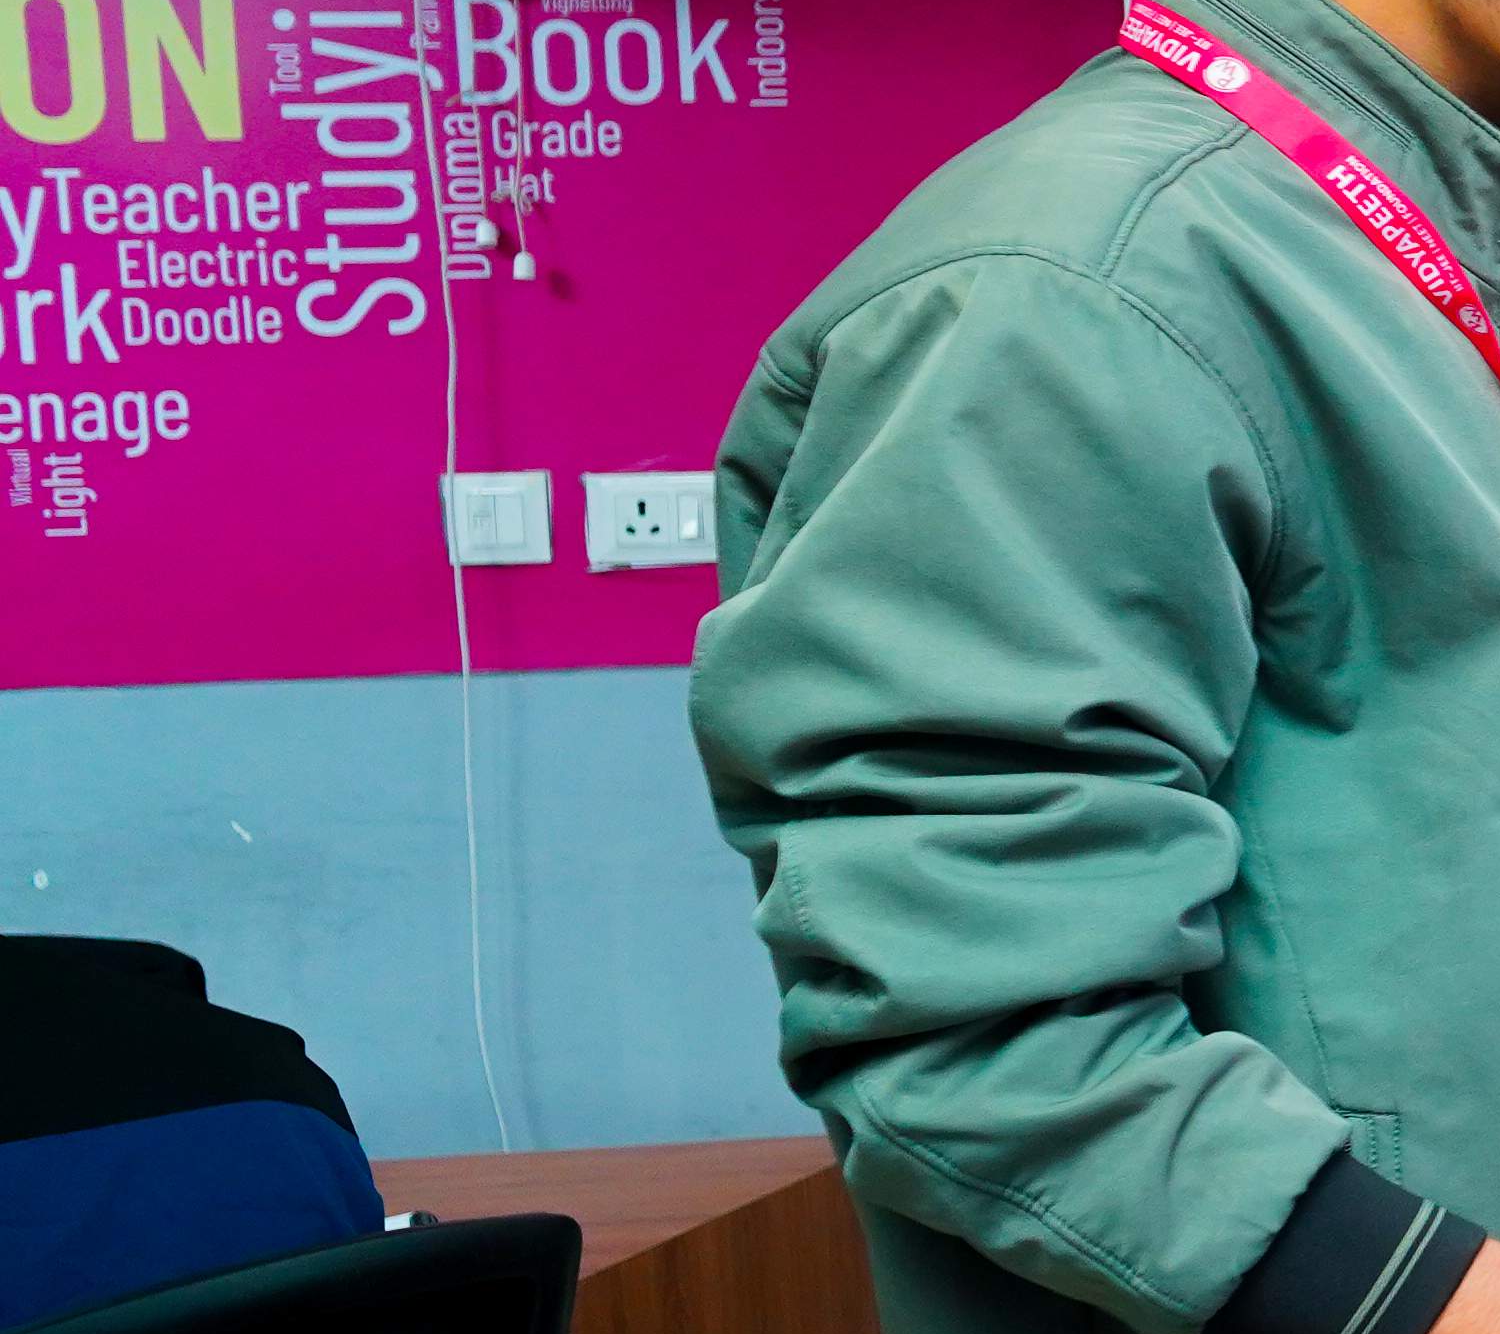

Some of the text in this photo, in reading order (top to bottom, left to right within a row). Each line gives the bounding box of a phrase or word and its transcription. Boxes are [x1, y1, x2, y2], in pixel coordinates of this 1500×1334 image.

[266, 42, 302, 97] Tool
[490, 109, 623, 158] Grade
[42, 166, 312, 235] Teacher
[493, 165, 556, 204] Hat
[1344, 152, 1412, 219] FOUNDATION
[118, 239, 300, 289] Electric
[1324, 161, 1451, 306] VIDYAPEETH
[0, 263, 121, 365] rk
[122, 295, 283, 347] Doodle
[42, 452, 97, 537] Light
